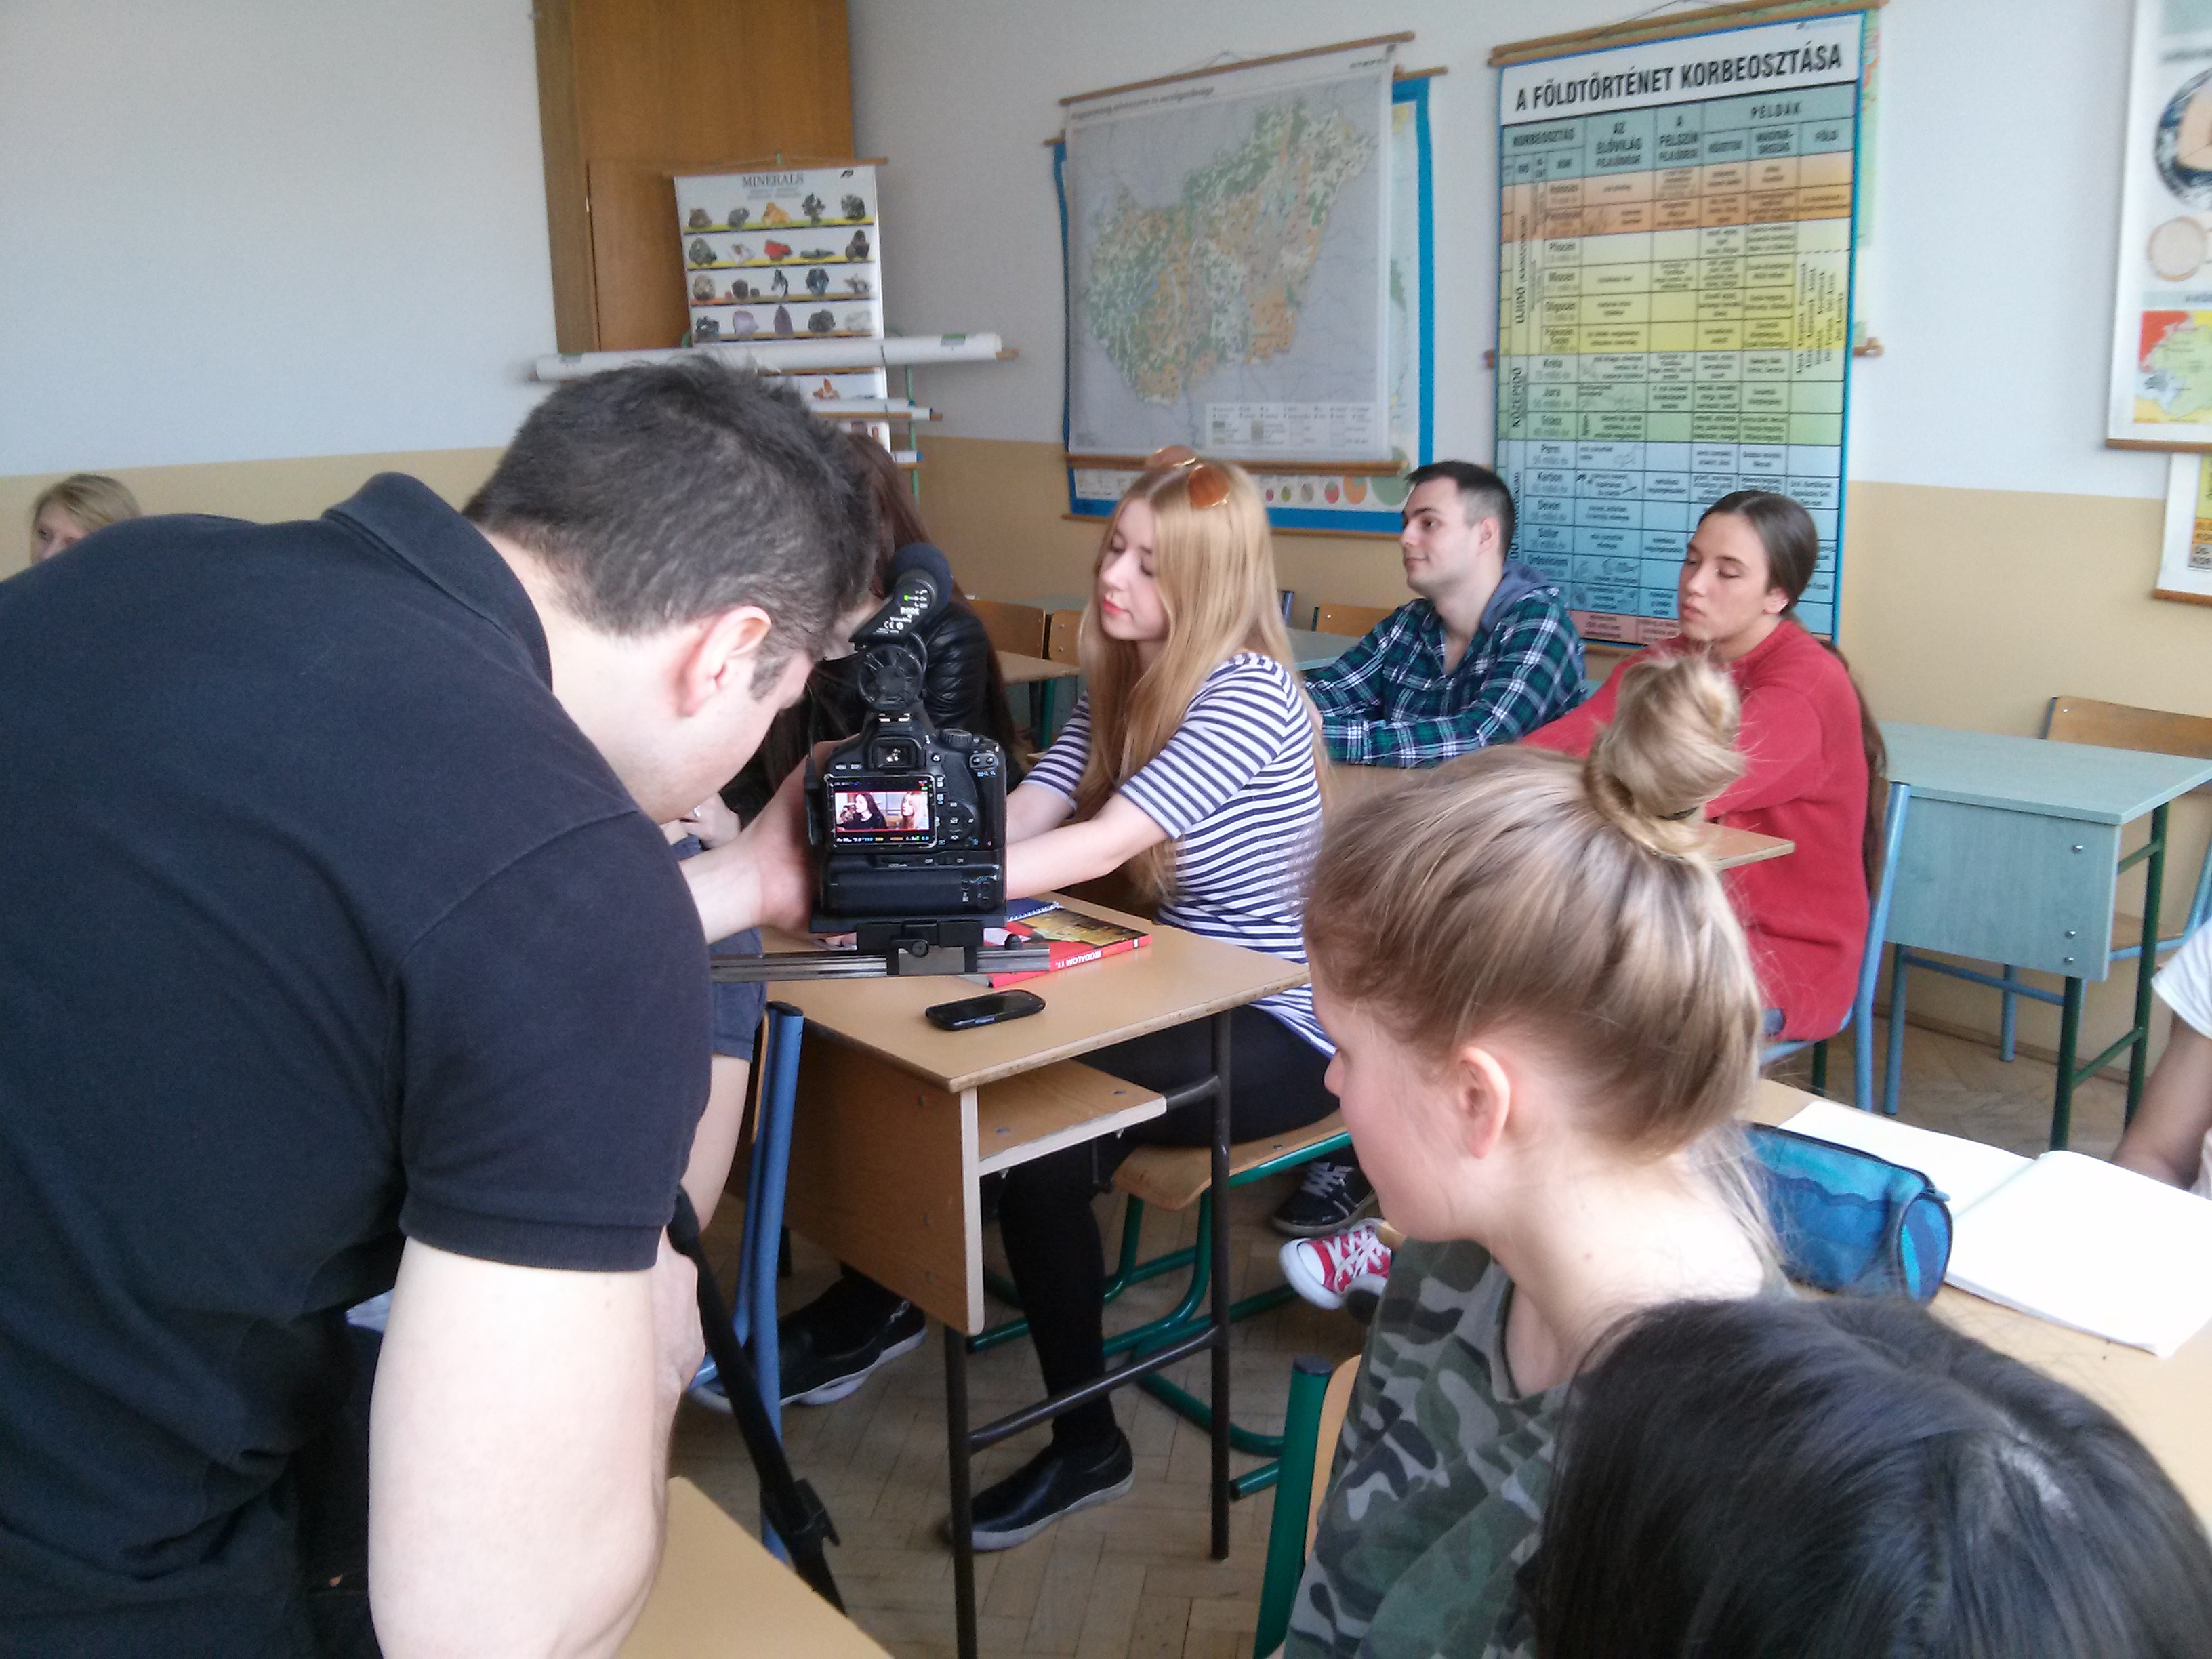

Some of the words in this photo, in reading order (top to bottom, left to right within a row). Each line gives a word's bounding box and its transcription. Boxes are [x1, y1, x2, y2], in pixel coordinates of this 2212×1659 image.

[1515, 88, 1526, 112] A
[1681, 41, 1841, 89] KORBEOSZTÁSA
[743, 172, 805, 188] MINERALS
[1066, 949, 1102, 966] IRODALOM
